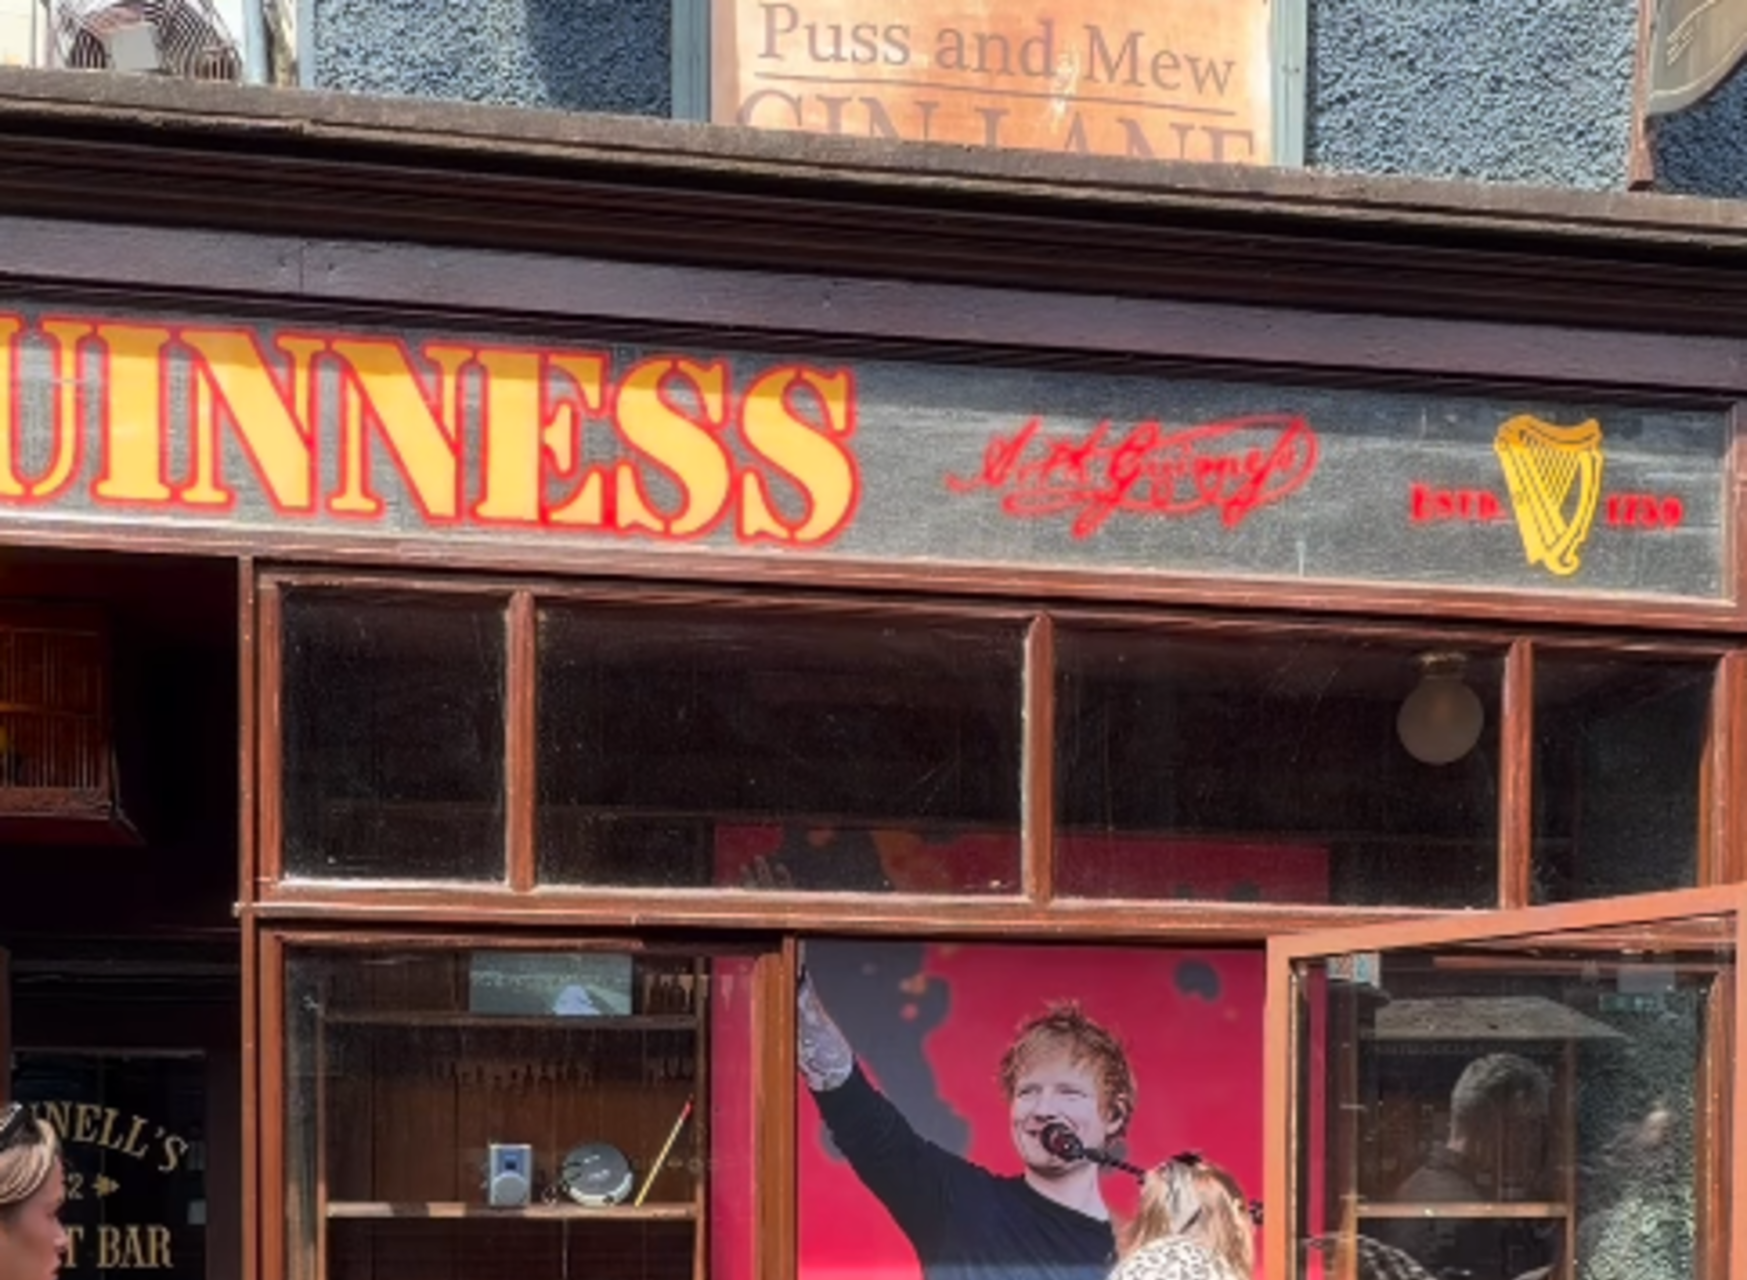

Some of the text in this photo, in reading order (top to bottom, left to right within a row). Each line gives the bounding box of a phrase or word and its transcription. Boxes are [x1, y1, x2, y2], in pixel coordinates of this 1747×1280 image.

[757, 2, 1237, 97] Puss and Mew
[97, 1223, 174, 1269] BAR
